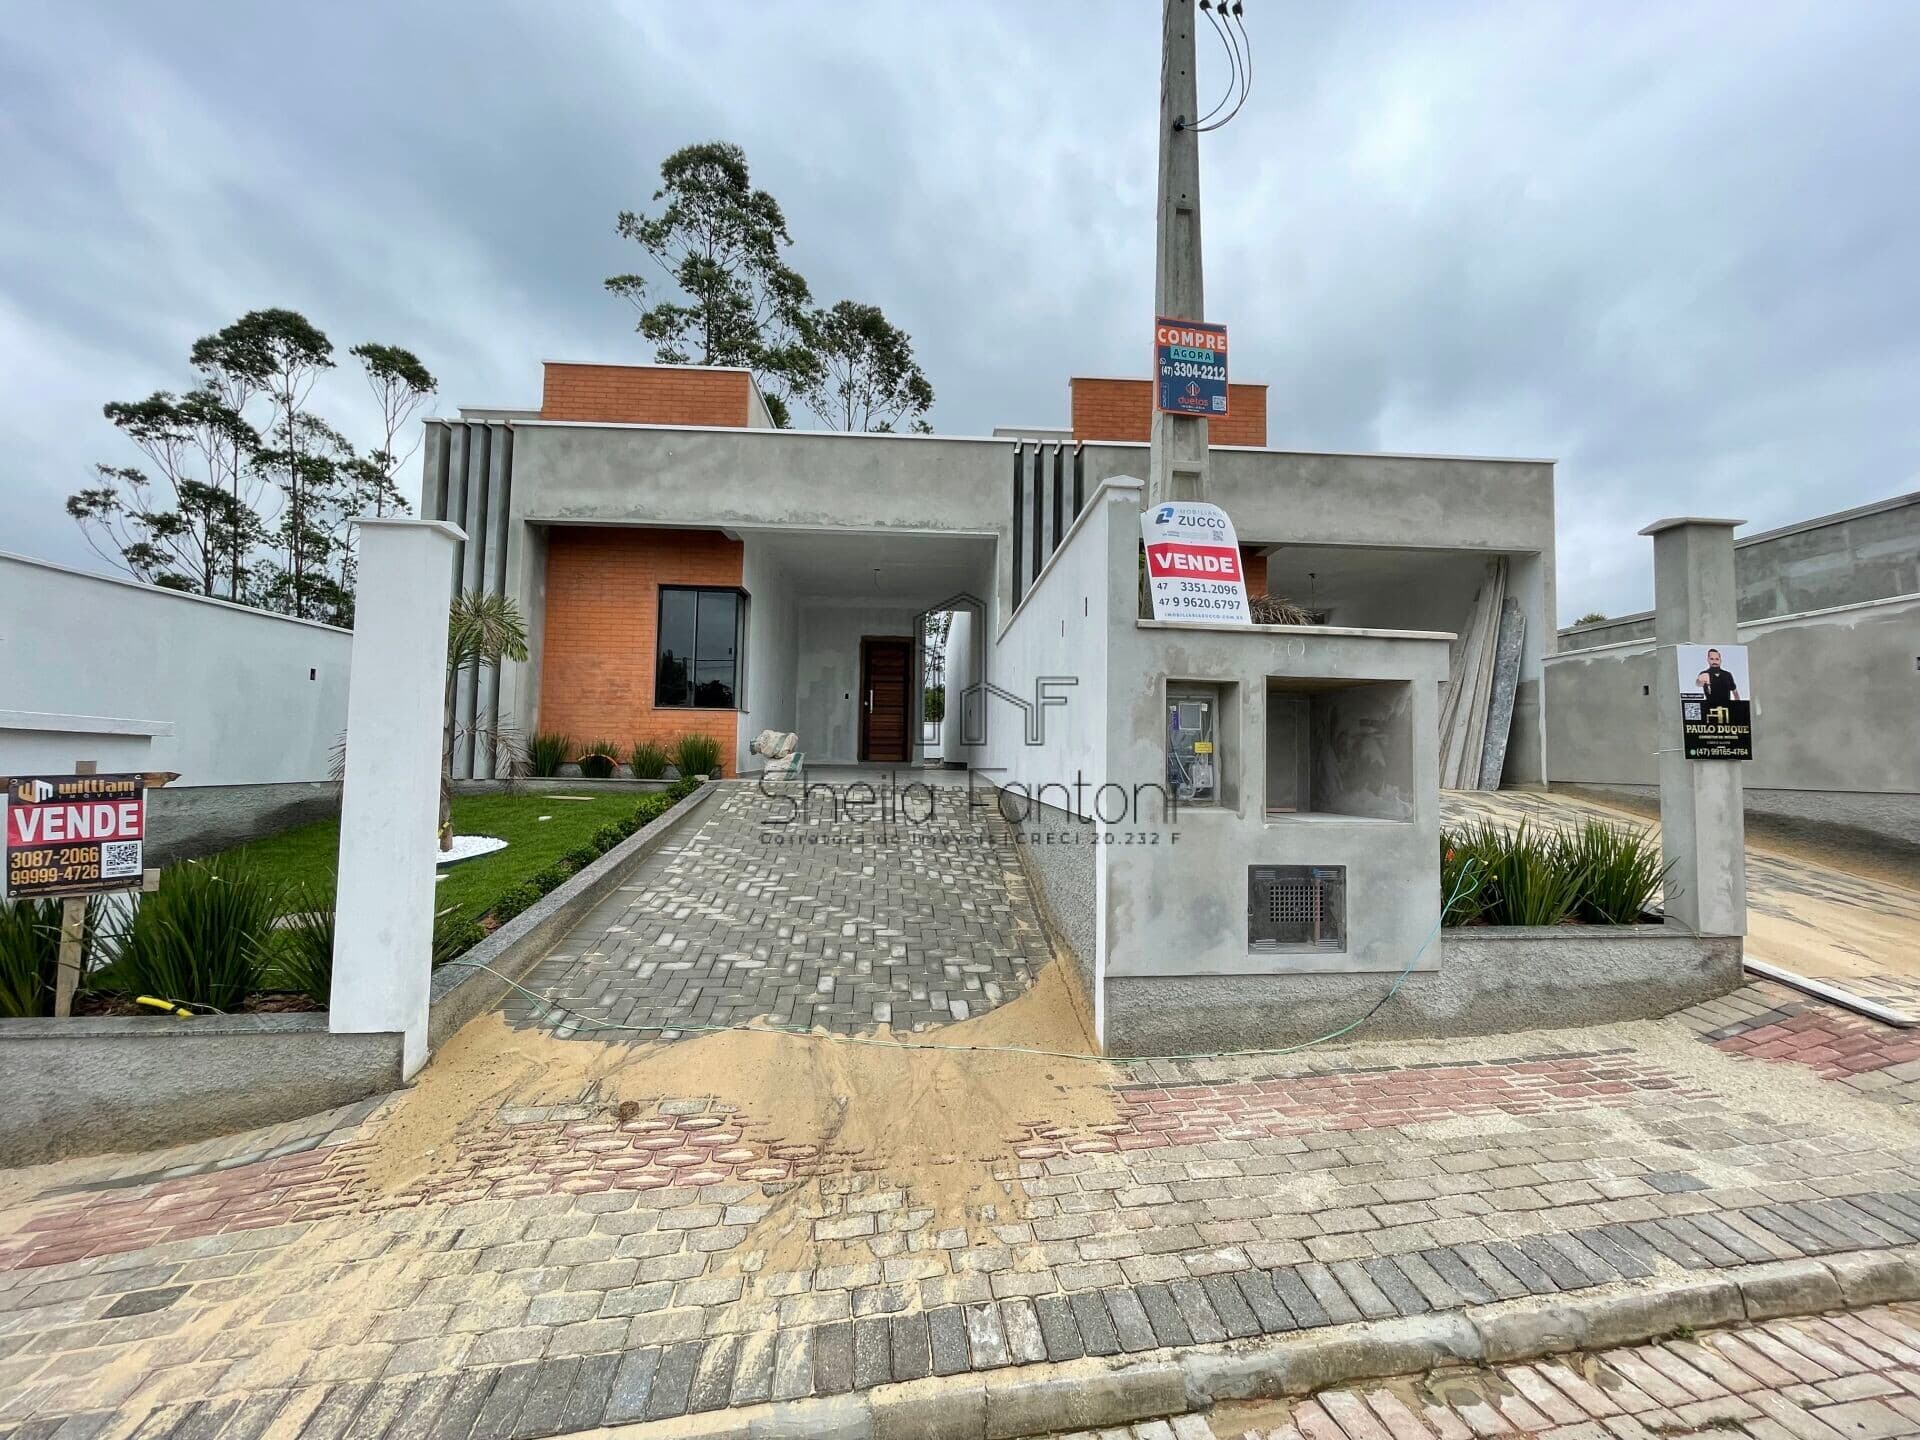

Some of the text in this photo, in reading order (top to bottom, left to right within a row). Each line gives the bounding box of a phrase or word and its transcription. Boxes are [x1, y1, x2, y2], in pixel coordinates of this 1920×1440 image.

[1158, 328, 1226, 350] COMPRE
[1173, 348, 1211, 360] AGORA
[1161, 362, 1226, 380] (47) 3304-2212
[1178, 516, 1226, 529] ZUCCO
[1155, 553, 1234, 573] VENDE
[1180, 582, 1238, 595] 3351.2096
[1159, 598, 1170, 606] 47
[1686, 724, 1750, 735] PAULO DUQUE
[1696, 748, 1710, 757] (47)
[14, 803, 139, 842] VENDE
[11, 847, 99, 869] 3087-2066
[11, 864, 99, 886] 99999-4726
